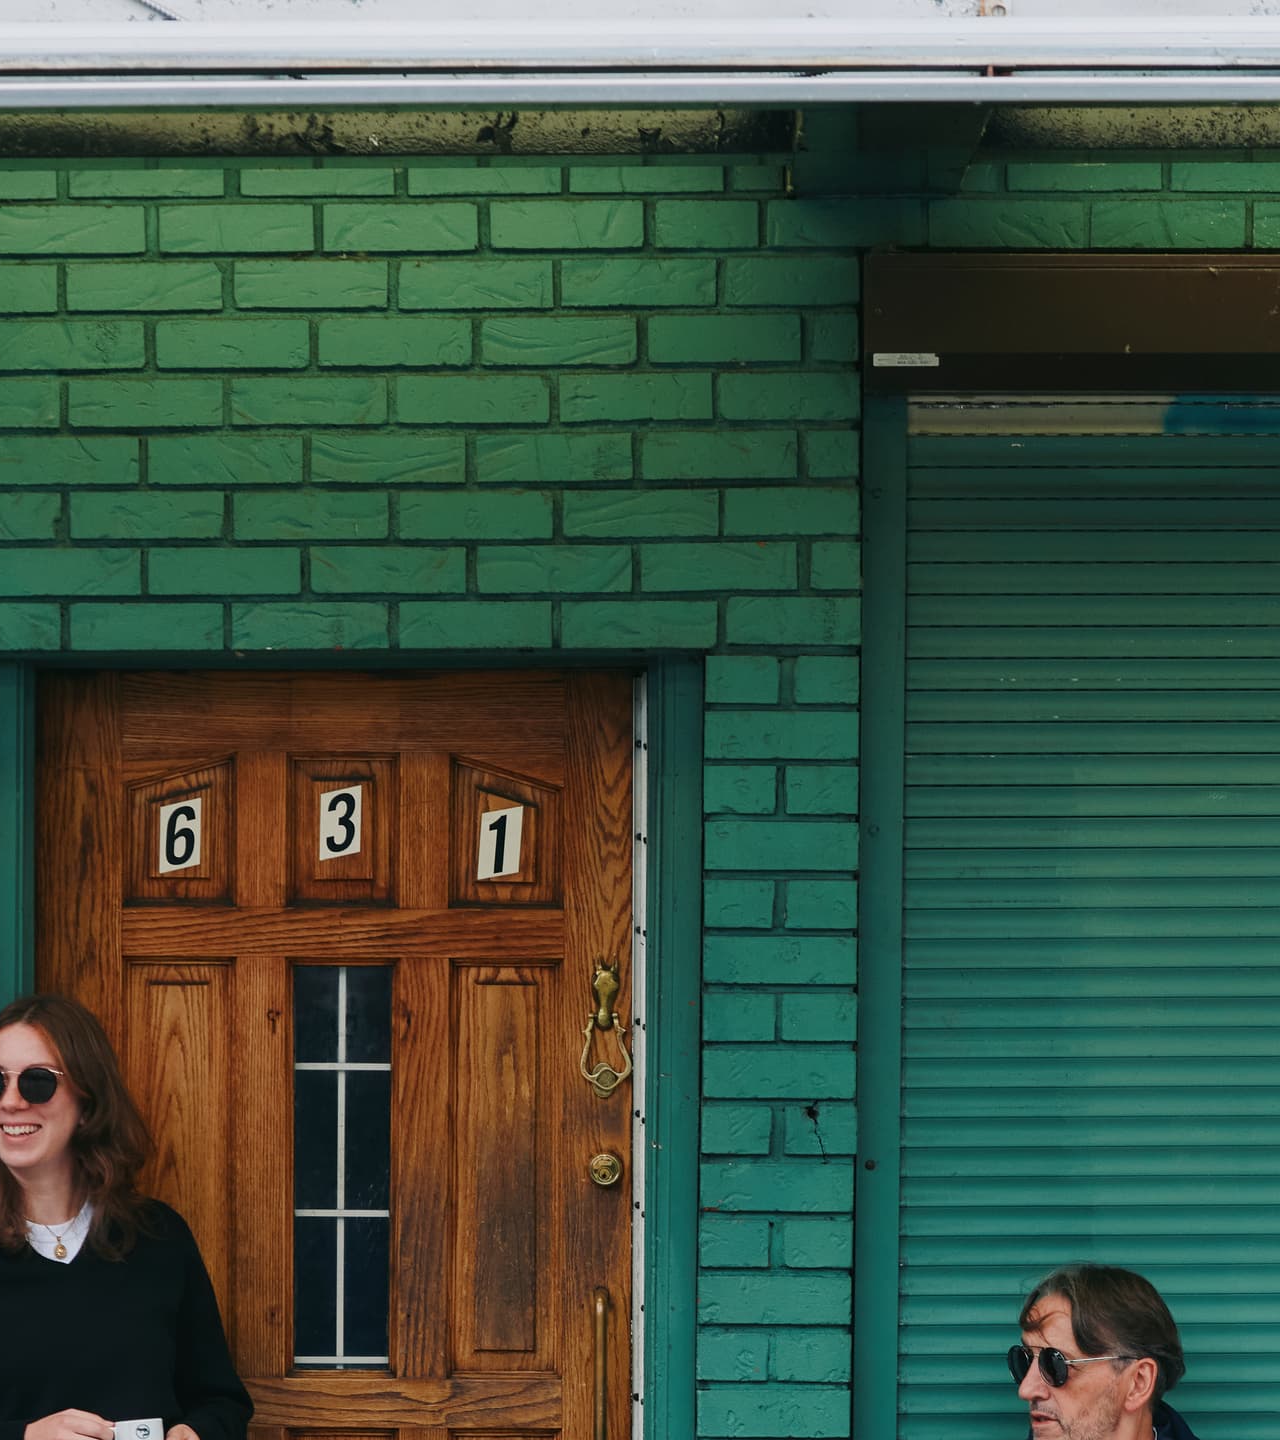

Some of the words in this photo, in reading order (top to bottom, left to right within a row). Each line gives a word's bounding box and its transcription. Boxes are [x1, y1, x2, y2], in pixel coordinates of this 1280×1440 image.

[165, 805, 196, 866] 6
[326, 792, 356, 853] 3
[488, 814, 508, 874] 1
